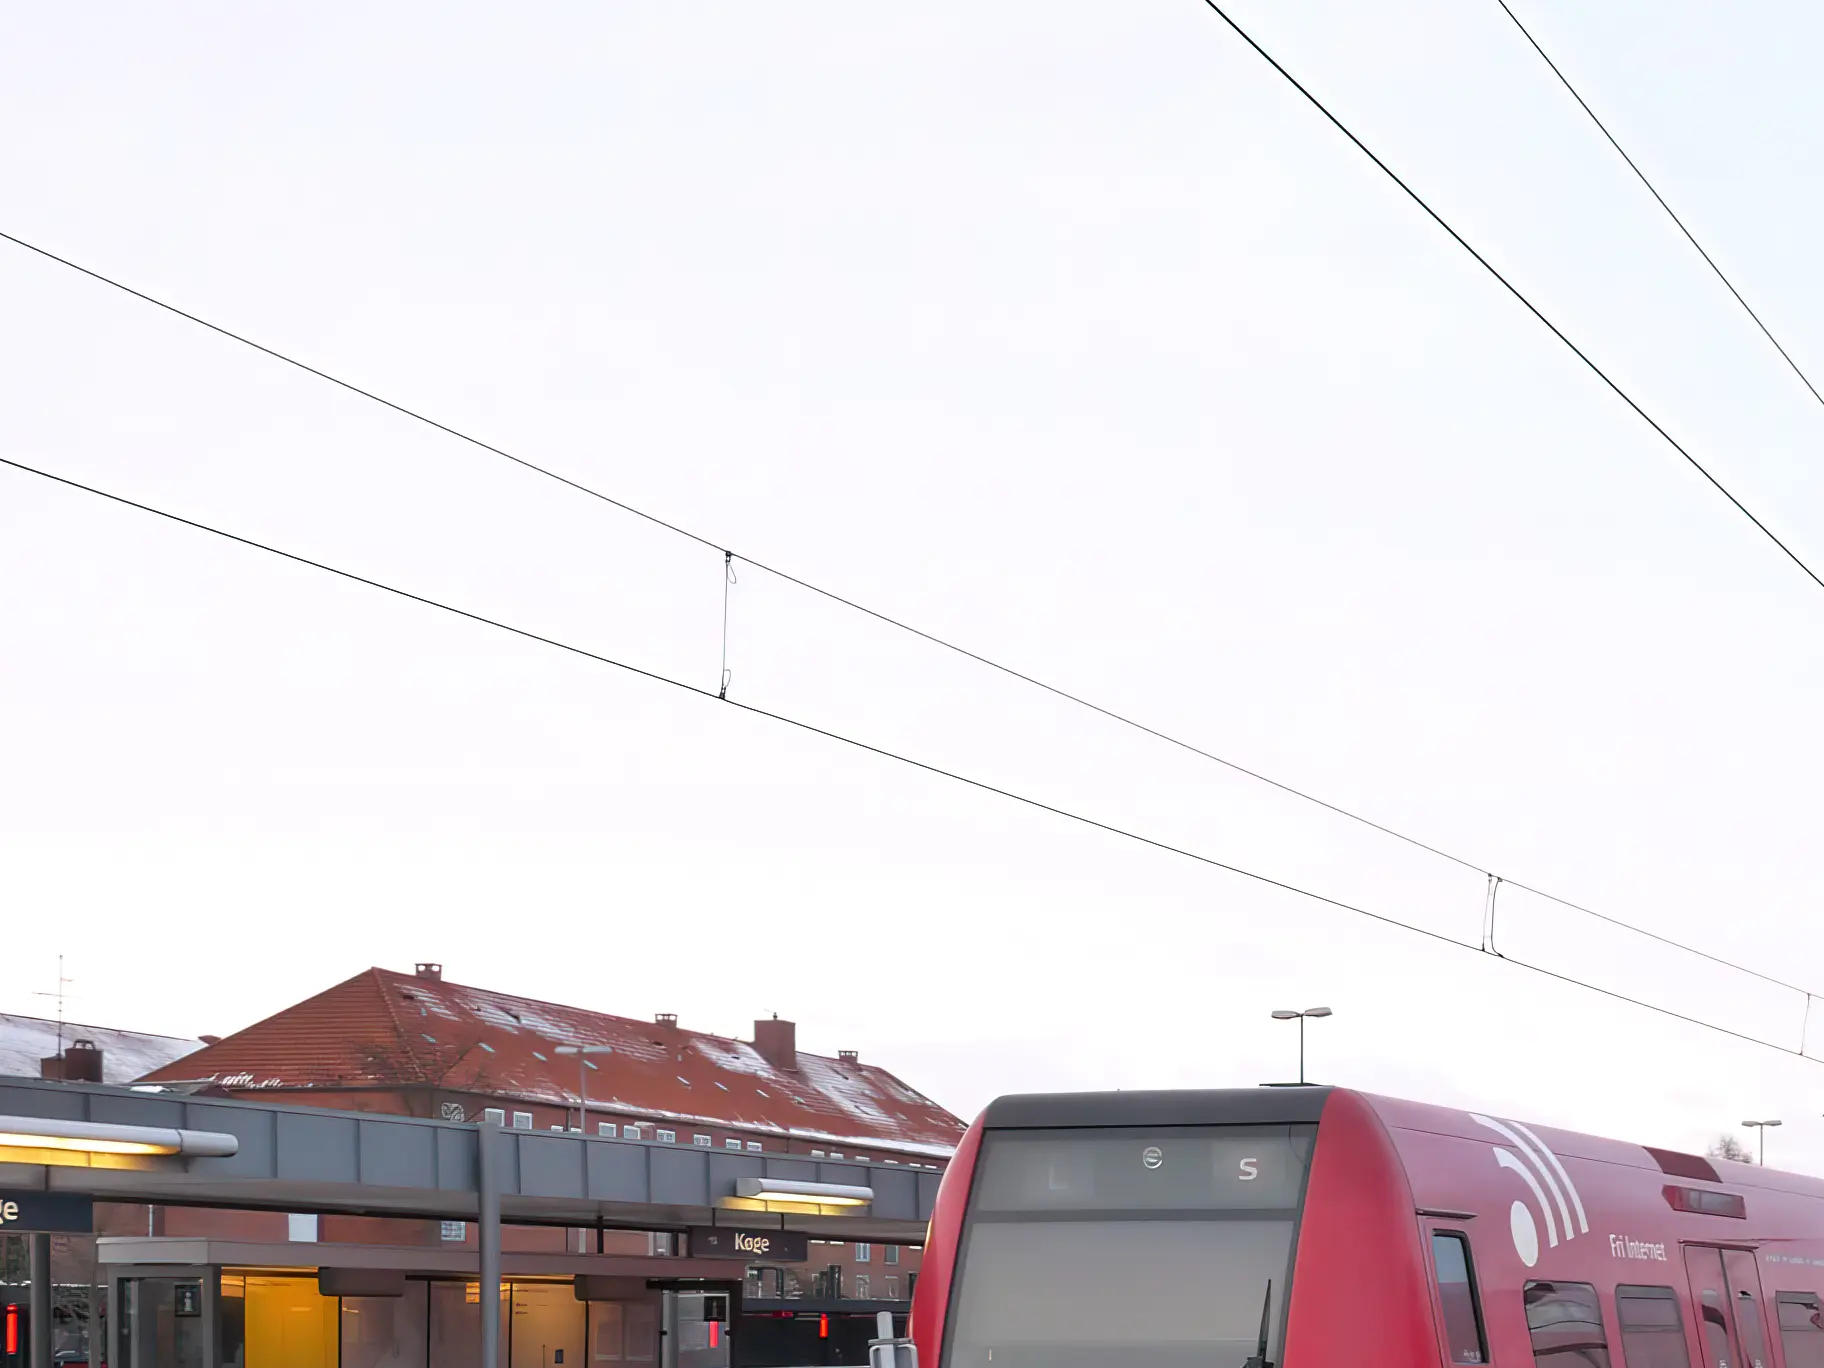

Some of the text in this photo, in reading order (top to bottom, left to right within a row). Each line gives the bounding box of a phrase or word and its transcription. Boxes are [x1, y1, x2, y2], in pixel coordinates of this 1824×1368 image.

[1238, 1157, 1258, 1181] S
[1609, 1233, 1668, 1261] Fri Internet
